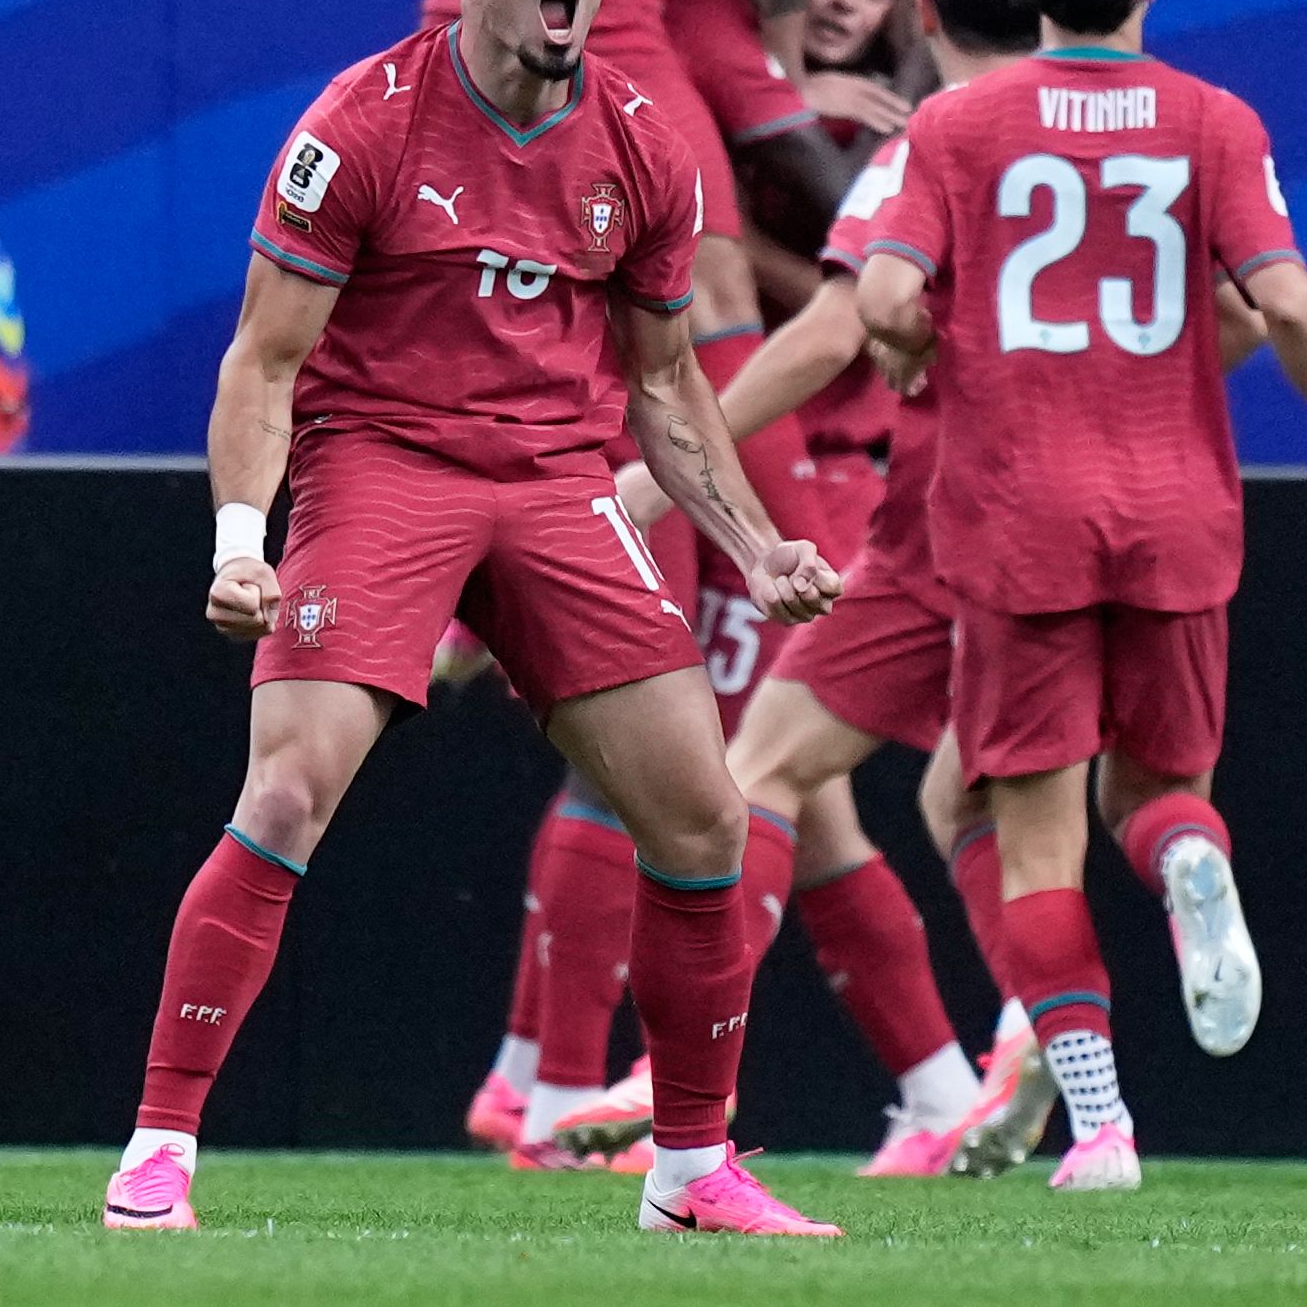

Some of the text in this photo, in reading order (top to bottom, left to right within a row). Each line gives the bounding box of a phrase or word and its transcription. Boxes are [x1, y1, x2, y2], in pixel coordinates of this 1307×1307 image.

[1038, 86, 1157, 132] VITINHA
[996, 153, 1191, 357] 23
[591, 495, 665, 592] 1
